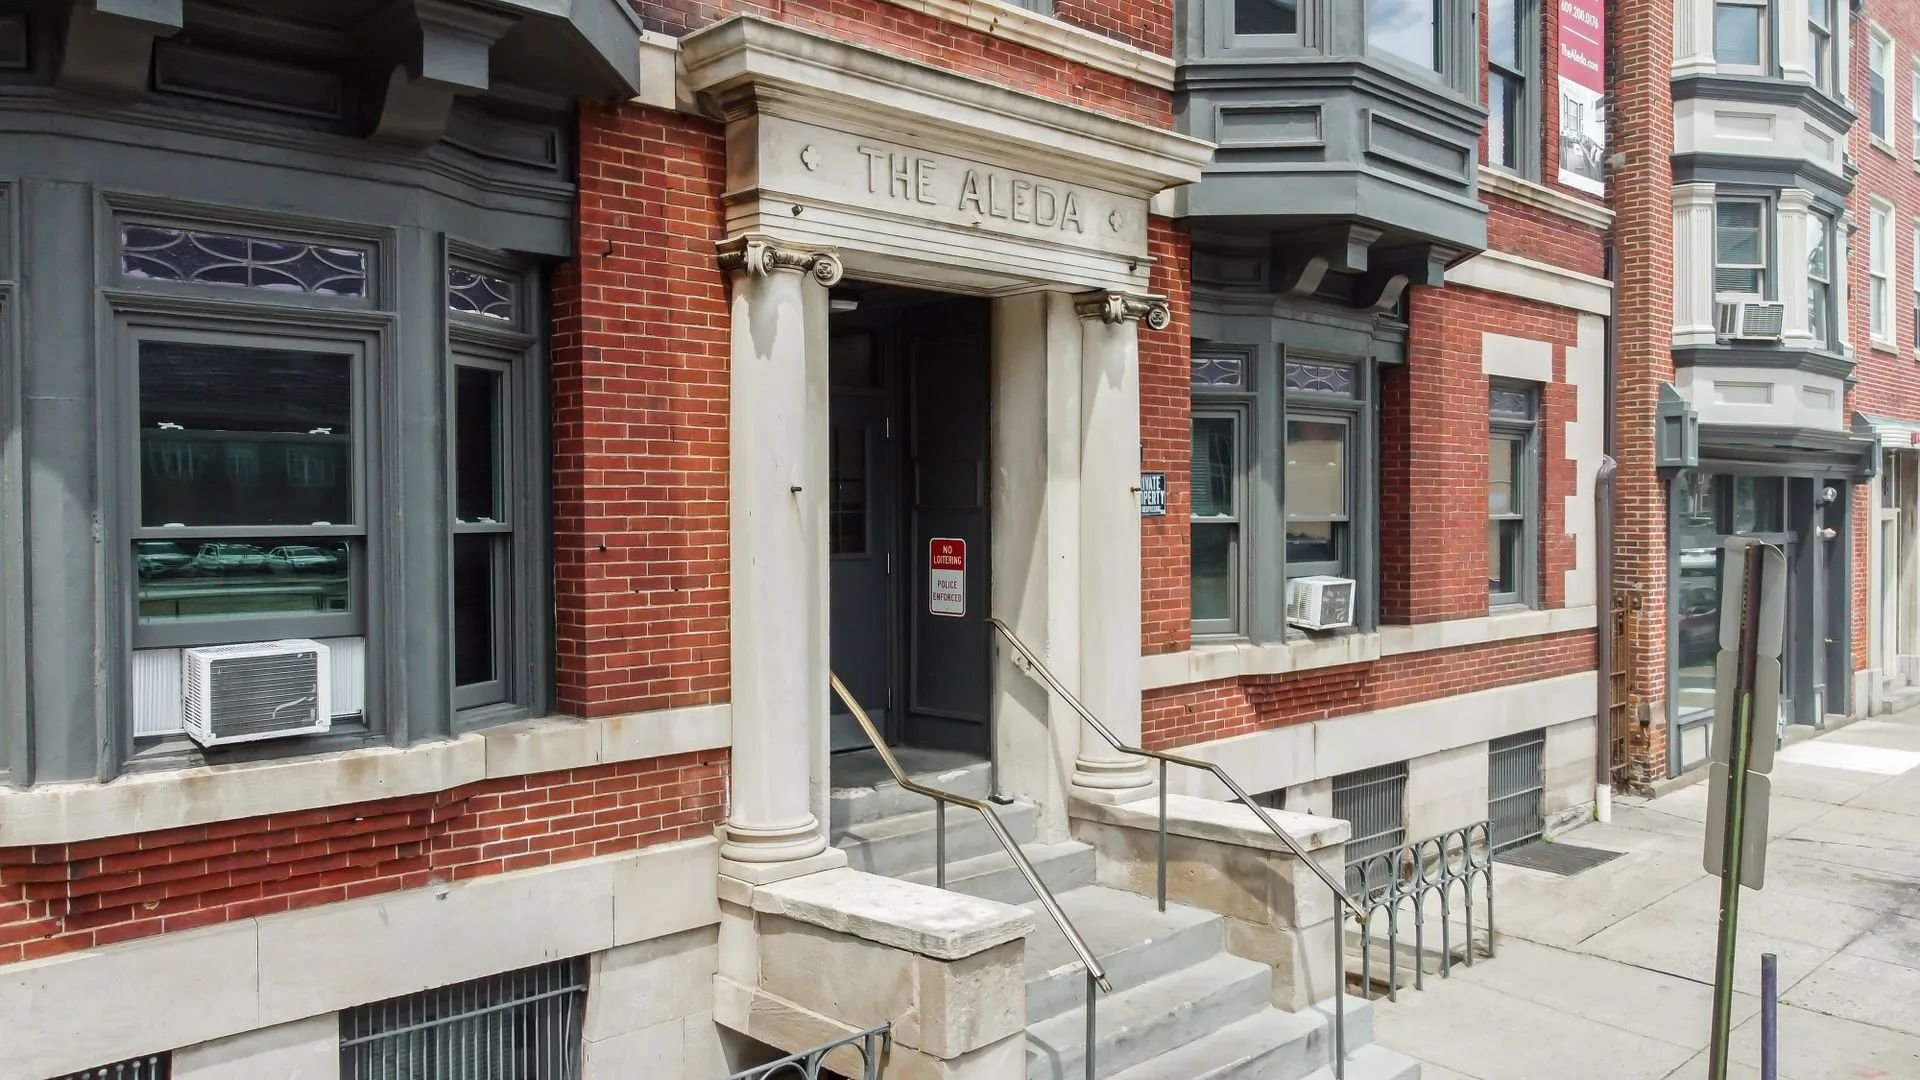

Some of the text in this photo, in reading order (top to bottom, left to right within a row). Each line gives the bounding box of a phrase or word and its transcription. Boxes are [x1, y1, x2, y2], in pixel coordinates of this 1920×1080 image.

[1561, 0, 1599, 29] 609.200.0176
[1561, 43, 1599, 72] TheAleda.com
[858, 145, 1084, 234] THE ALEDA
[1141, 476, 1161, 490] IVATE
[1141, 490, 1165, 505] PERTY
[942, 545, 953, 554] NO
[933, 555, 962, 565] LOITERING
[937, 580, 957, 590] POLICE
[933, 592, 962, 602] ENFORCED
